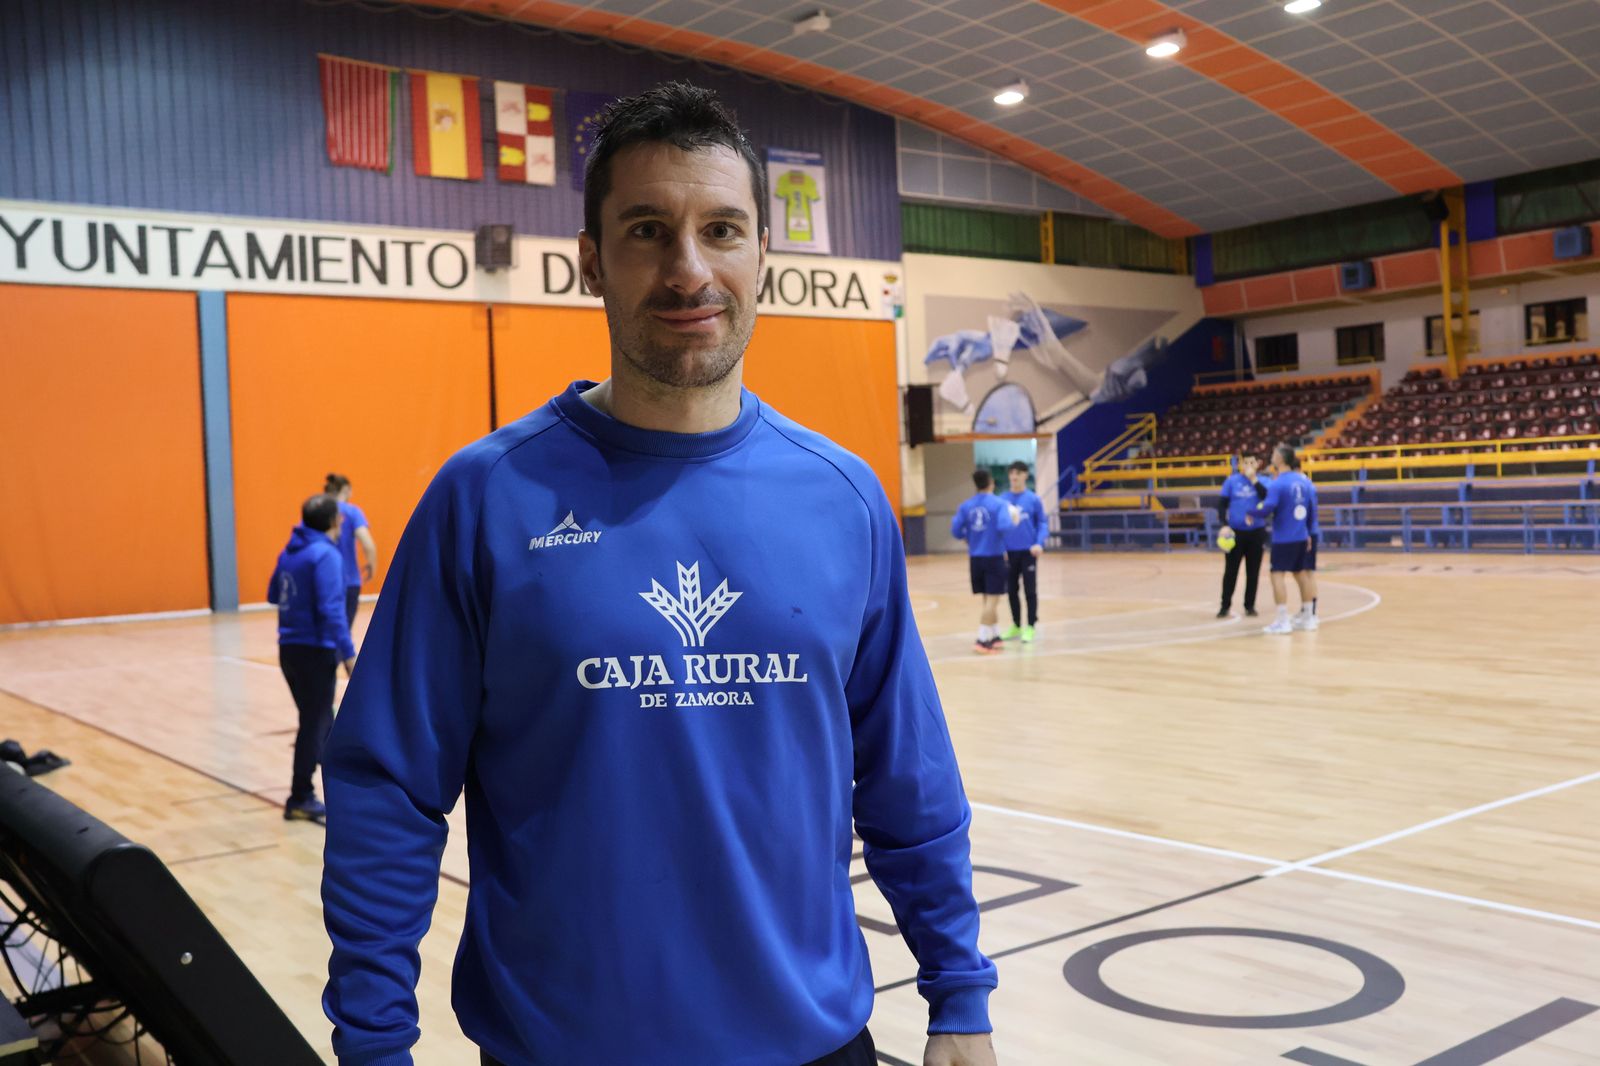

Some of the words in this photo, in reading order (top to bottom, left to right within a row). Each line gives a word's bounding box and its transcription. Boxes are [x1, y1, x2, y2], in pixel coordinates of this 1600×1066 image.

[0, 214, 469, 289] YUNTAMIENTO
[528, 530, 602, 550] MERCURY
[576, 654, 675, 690] CAJA
[683, 653, 808, 685] RURAL
[640, 693, 668, 709] DE
[675, 691, 754, 708] ZAMORA
